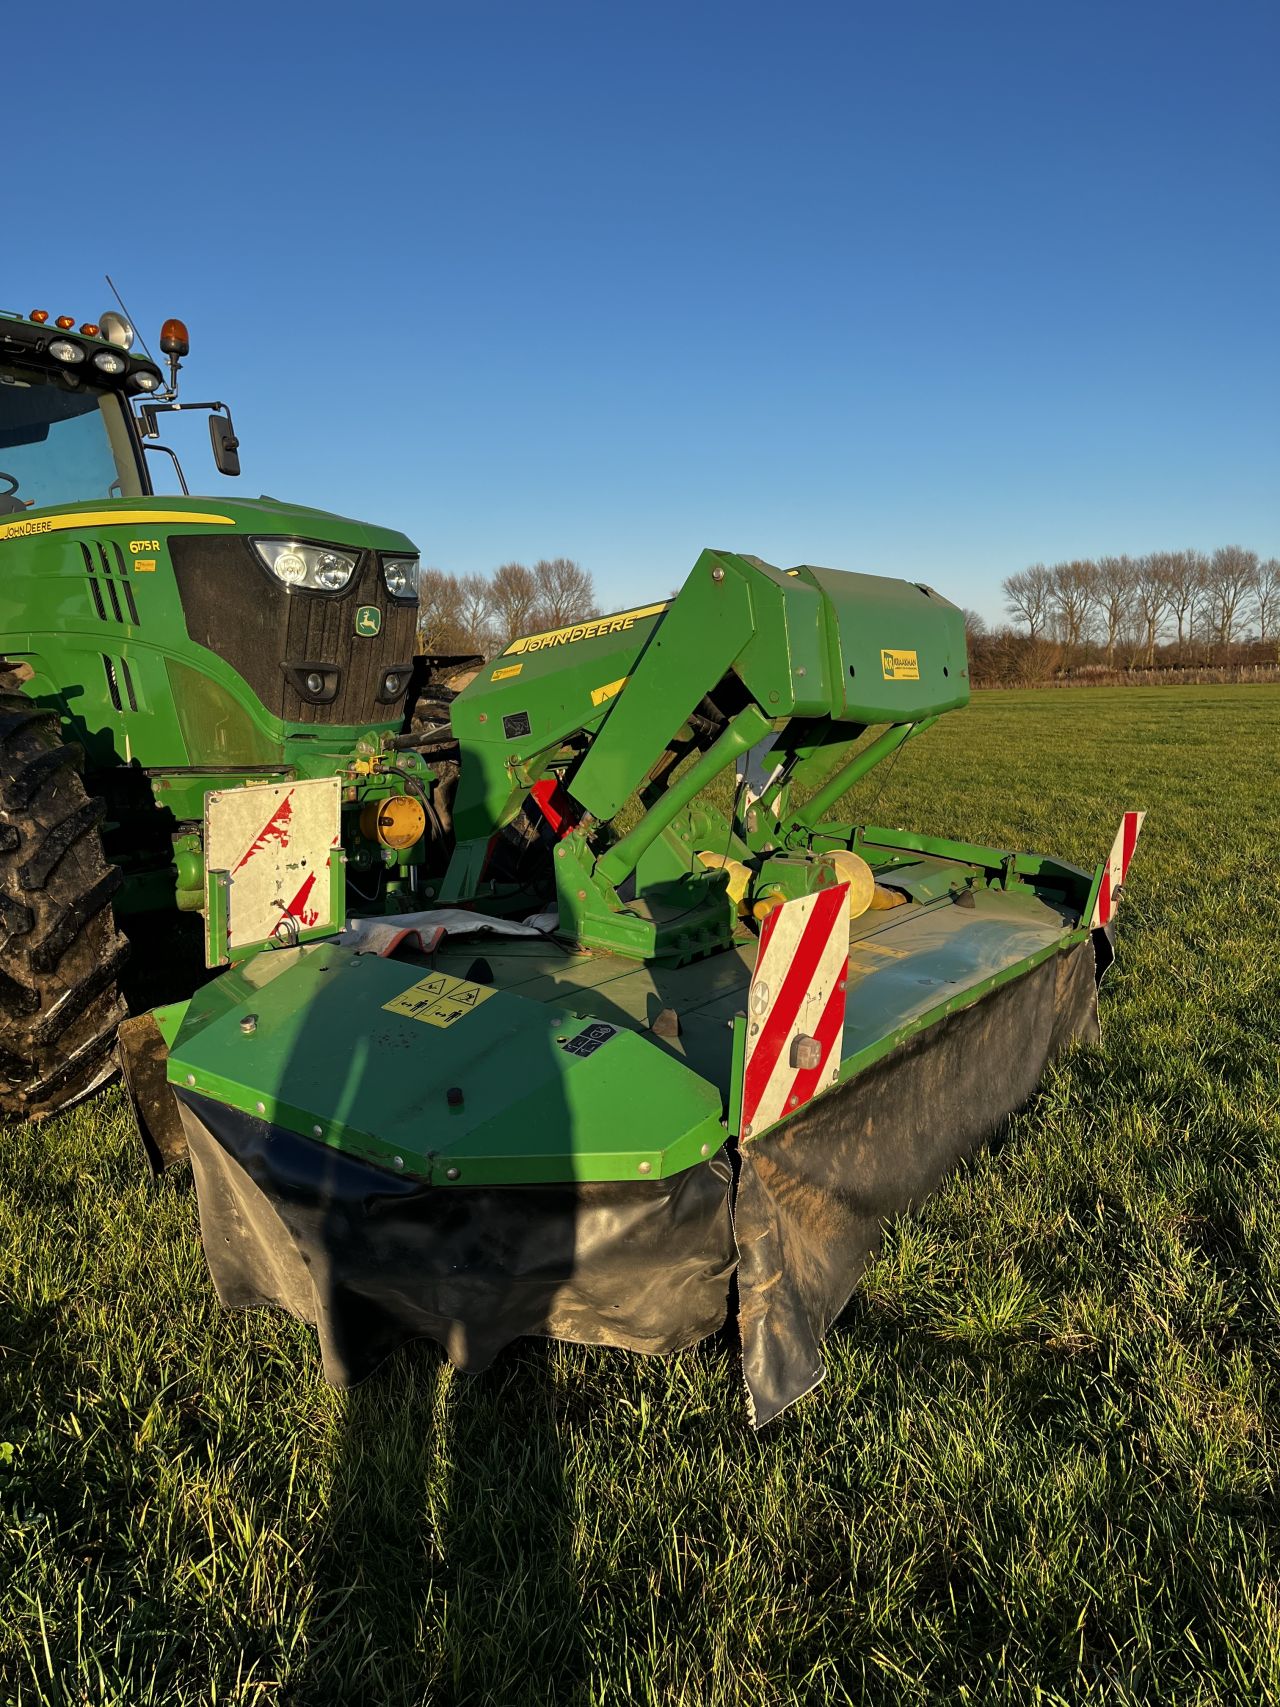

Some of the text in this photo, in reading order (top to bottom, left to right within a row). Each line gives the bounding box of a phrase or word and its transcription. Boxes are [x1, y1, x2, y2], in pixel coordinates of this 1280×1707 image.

[5, 521, 52, 539] JOHN DEERE
[517, 617, 636, 655] JOHN DEERE
